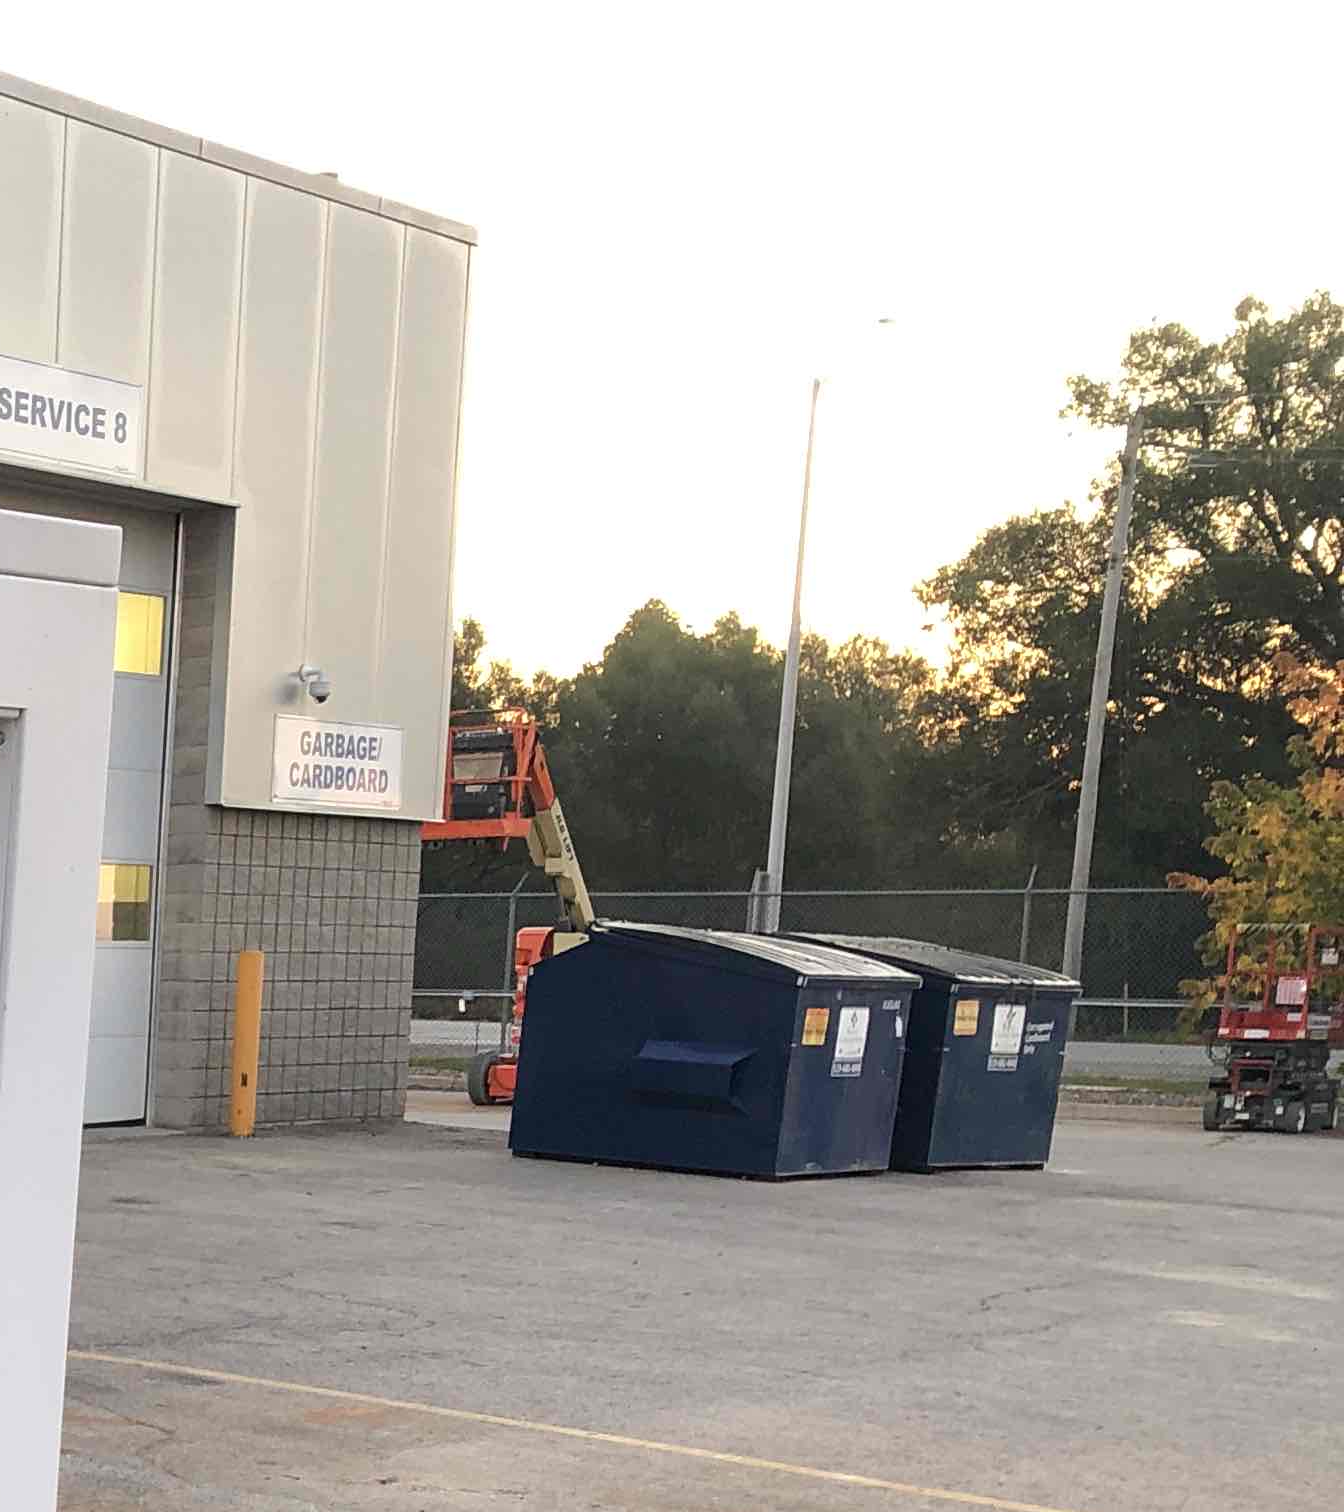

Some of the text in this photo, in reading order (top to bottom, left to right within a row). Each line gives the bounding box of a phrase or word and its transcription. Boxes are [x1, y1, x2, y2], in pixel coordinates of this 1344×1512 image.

[114, 411, 128, 444] 8
[300, 730, 383, 761] GARBAGE/
[289, 762, 389, 793] CARDBOARD
